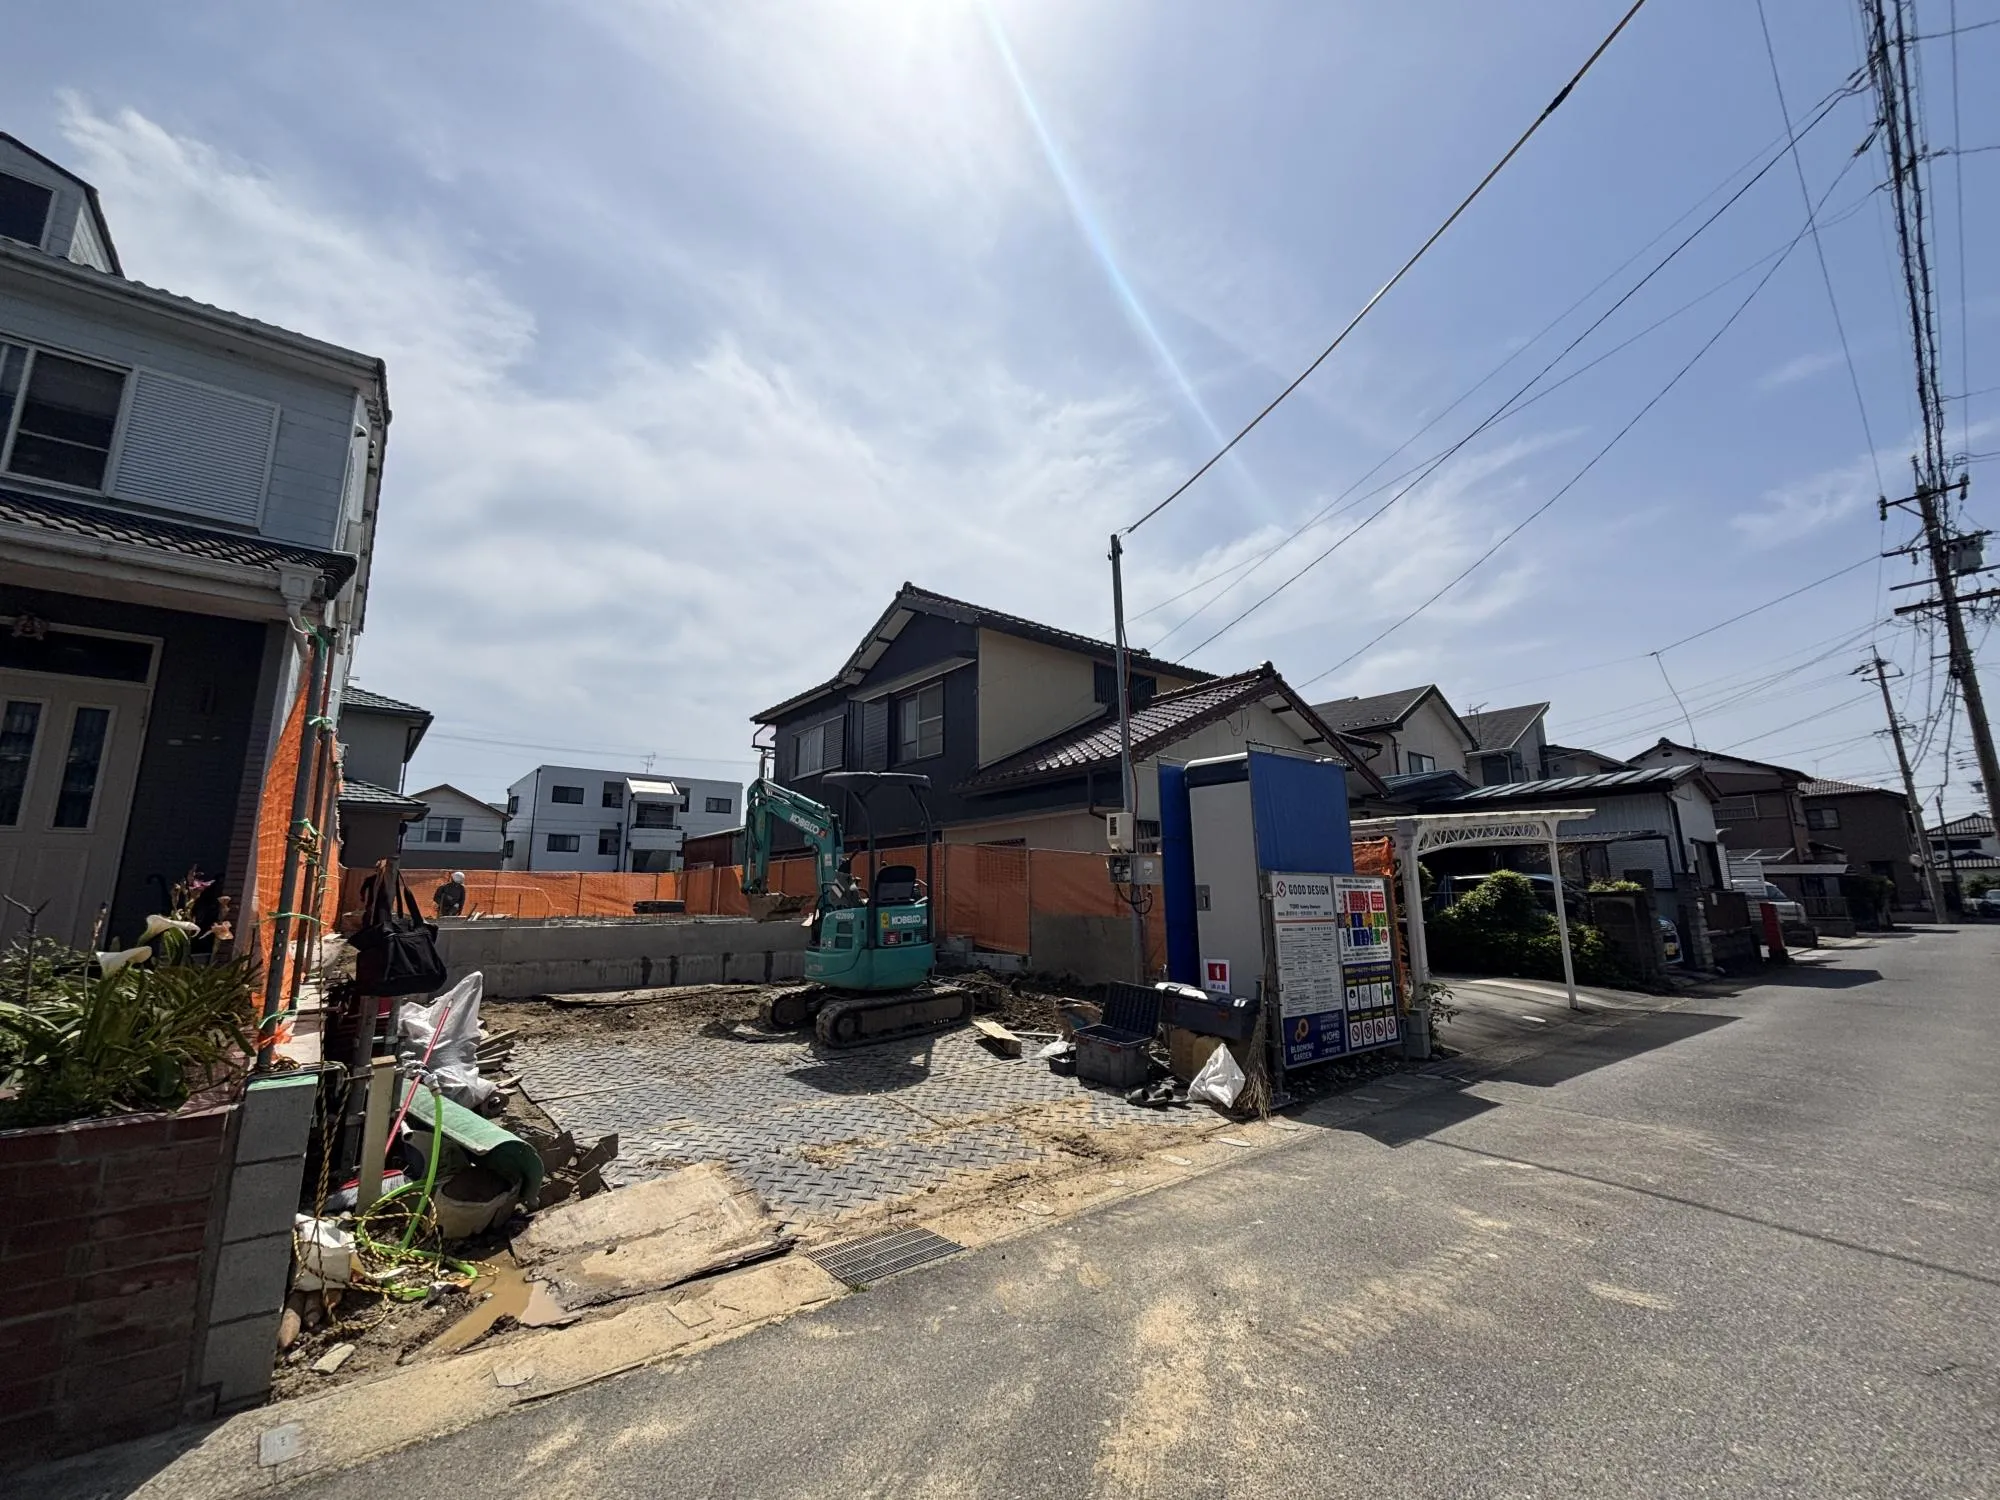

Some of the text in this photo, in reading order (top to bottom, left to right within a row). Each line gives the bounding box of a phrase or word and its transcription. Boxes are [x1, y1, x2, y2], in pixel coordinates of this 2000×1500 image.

[790, 812, 820, 835] KOBELCO
[1288, 884, 1307, 896] GOOD
[1307, 884, 1330, 896] DESIGN
[891, 914, 921, 925] KOBELCO
